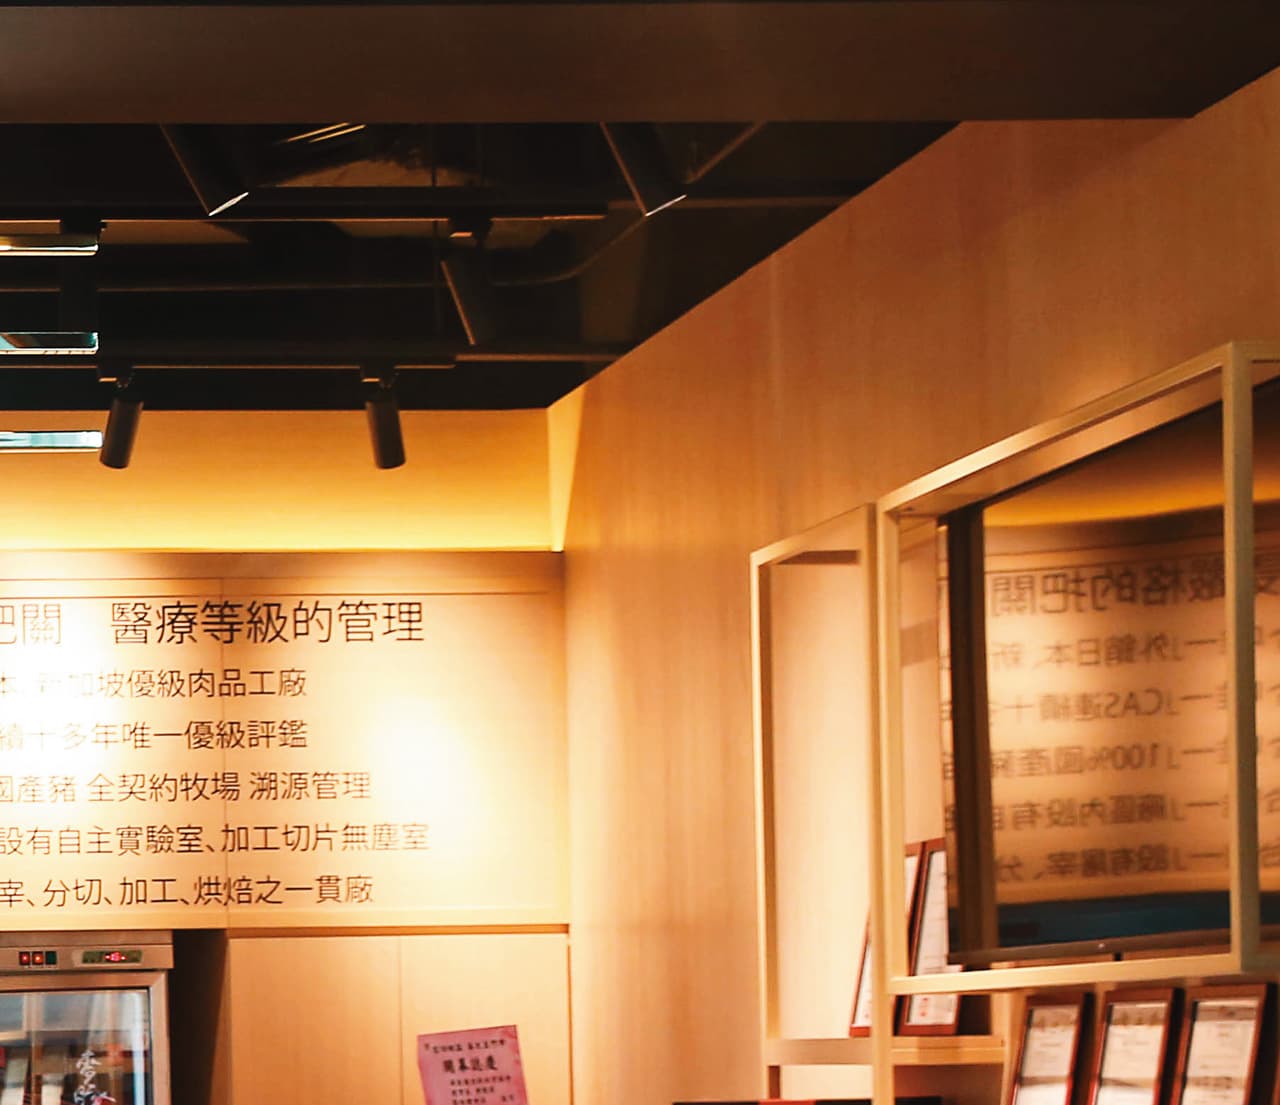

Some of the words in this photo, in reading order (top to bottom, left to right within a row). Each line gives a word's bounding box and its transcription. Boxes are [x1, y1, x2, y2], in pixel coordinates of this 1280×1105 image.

[111, 600, 425, 646] 醫療等級的管理
[87, 771, 241, 803] 全契約牧場
[249, 770, 373, 802] 溯源管理
